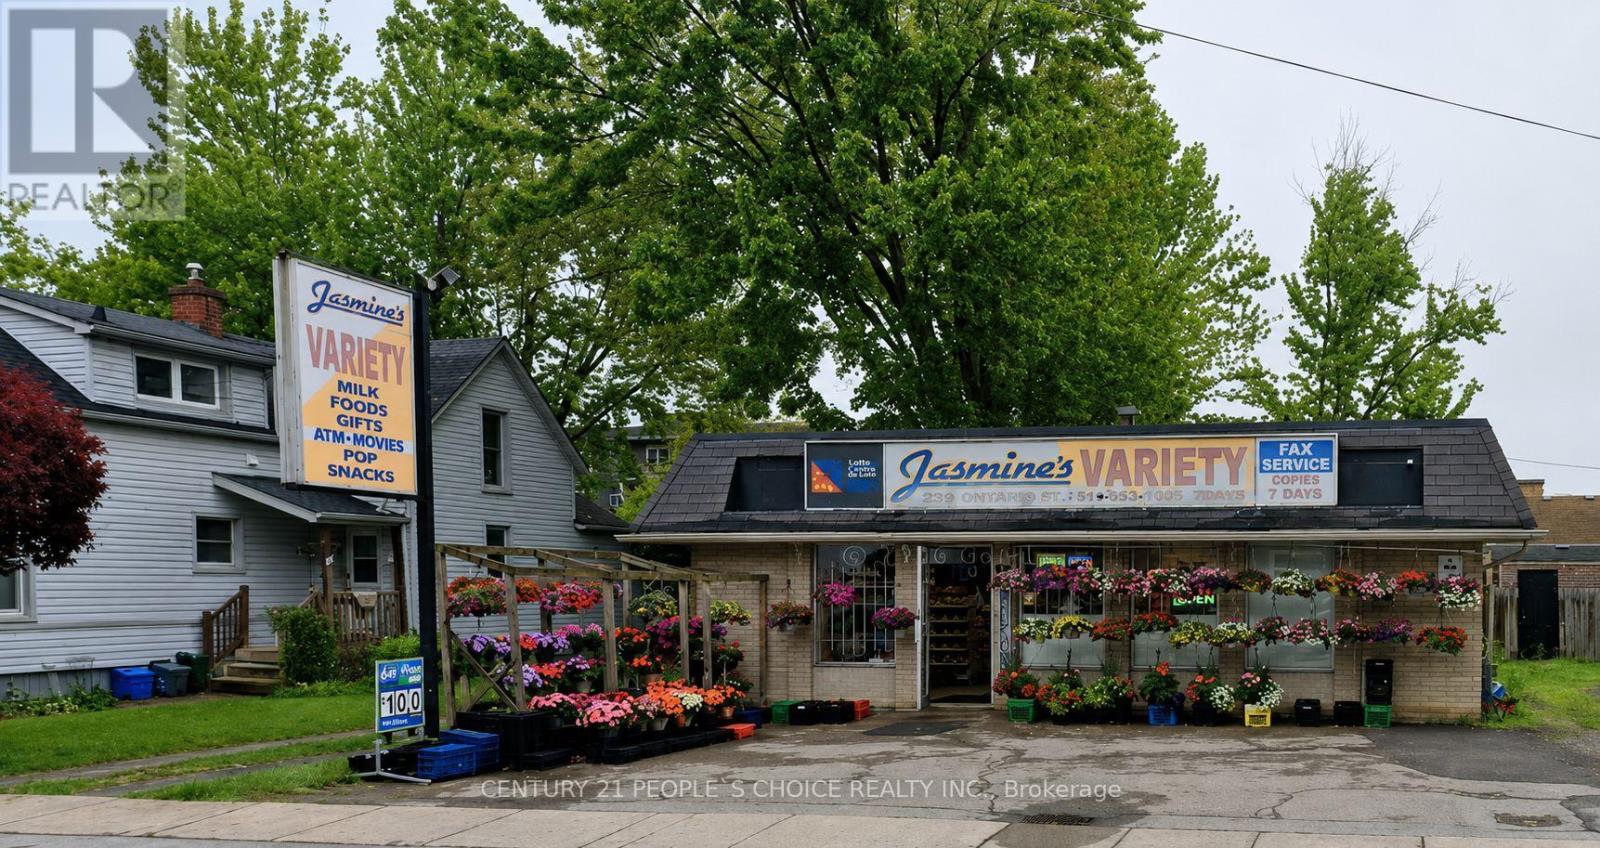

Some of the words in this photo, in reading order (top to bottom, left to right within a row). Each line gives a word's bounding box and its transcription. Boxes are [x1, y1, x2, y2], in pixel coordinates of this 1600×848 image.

[307, 280, 405, 326] Jasmine's
[306, 324, 405, 386] VARIETY
[337, 379, 379, 399] MILK
[330, 395, 388, 417] FOODS
[336, 414, 383, 432] GIFTS
[343, 448, 378, 464] POP
[1278, 442, 1313, 456] FAX
[327, 464, 395, 483] SNACKS
[1079, 446, 1248, 488] VARIETY
[1261, 457, 1330, 472] SERVICE
[891, 449, 1074, 503] Jasmine's
[1271, 474, 1320, 486] COPIES
[922, 492, 955, 503] 239
[961, 491, 1036, 504] ONTARIO
[1268, 488, 1276, 500] 7
[1282, 488, 1322, 500] DAYS
[1173, 594, 1215, 605] OEN
